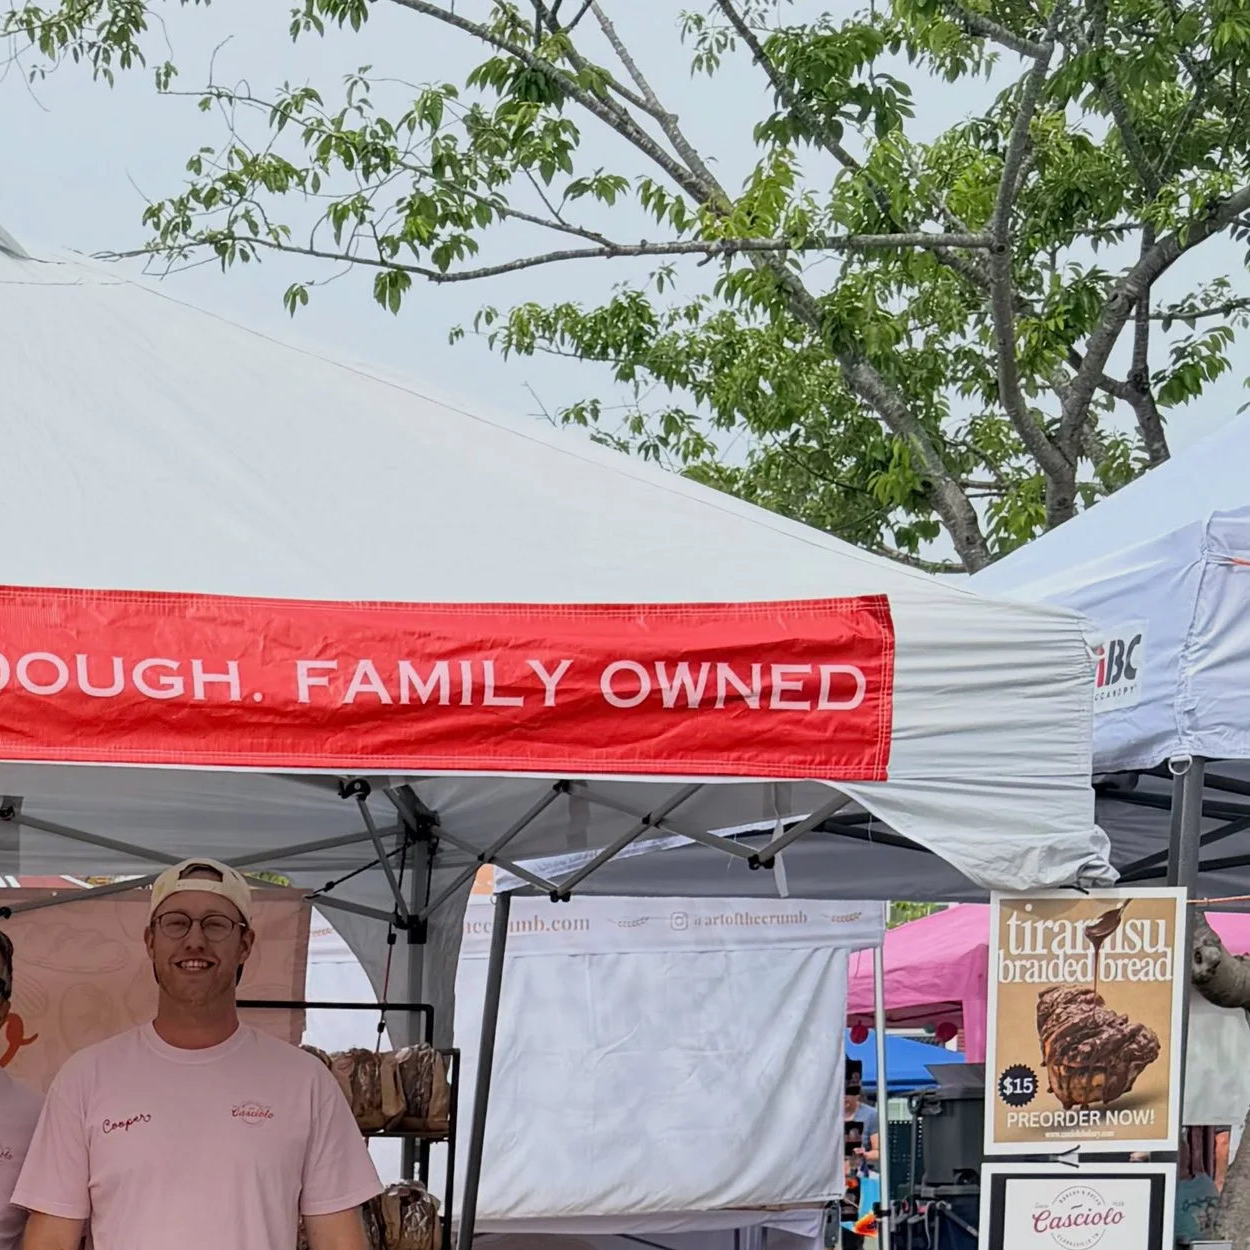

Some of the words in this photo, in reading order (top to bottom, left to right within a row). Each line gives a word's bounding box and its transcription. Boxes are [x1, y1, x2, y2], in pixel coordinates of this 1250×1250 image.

[295, 658, 574, 709] FAMILY
[600, 659, 867, 712] OWNED
[998, 949, 1094, 984] braided
[1100, 947, 1173, 983] bread
[1002, 1076, 1034, 1096] $15
[102, 1114, 151, 1134] Cooper
[1007, 1110, 1100, 1128] PREORDER
[1105, 1109, 1155, 1126] NOW!
[1032, 1204, 1125, 1233] Casciolo
